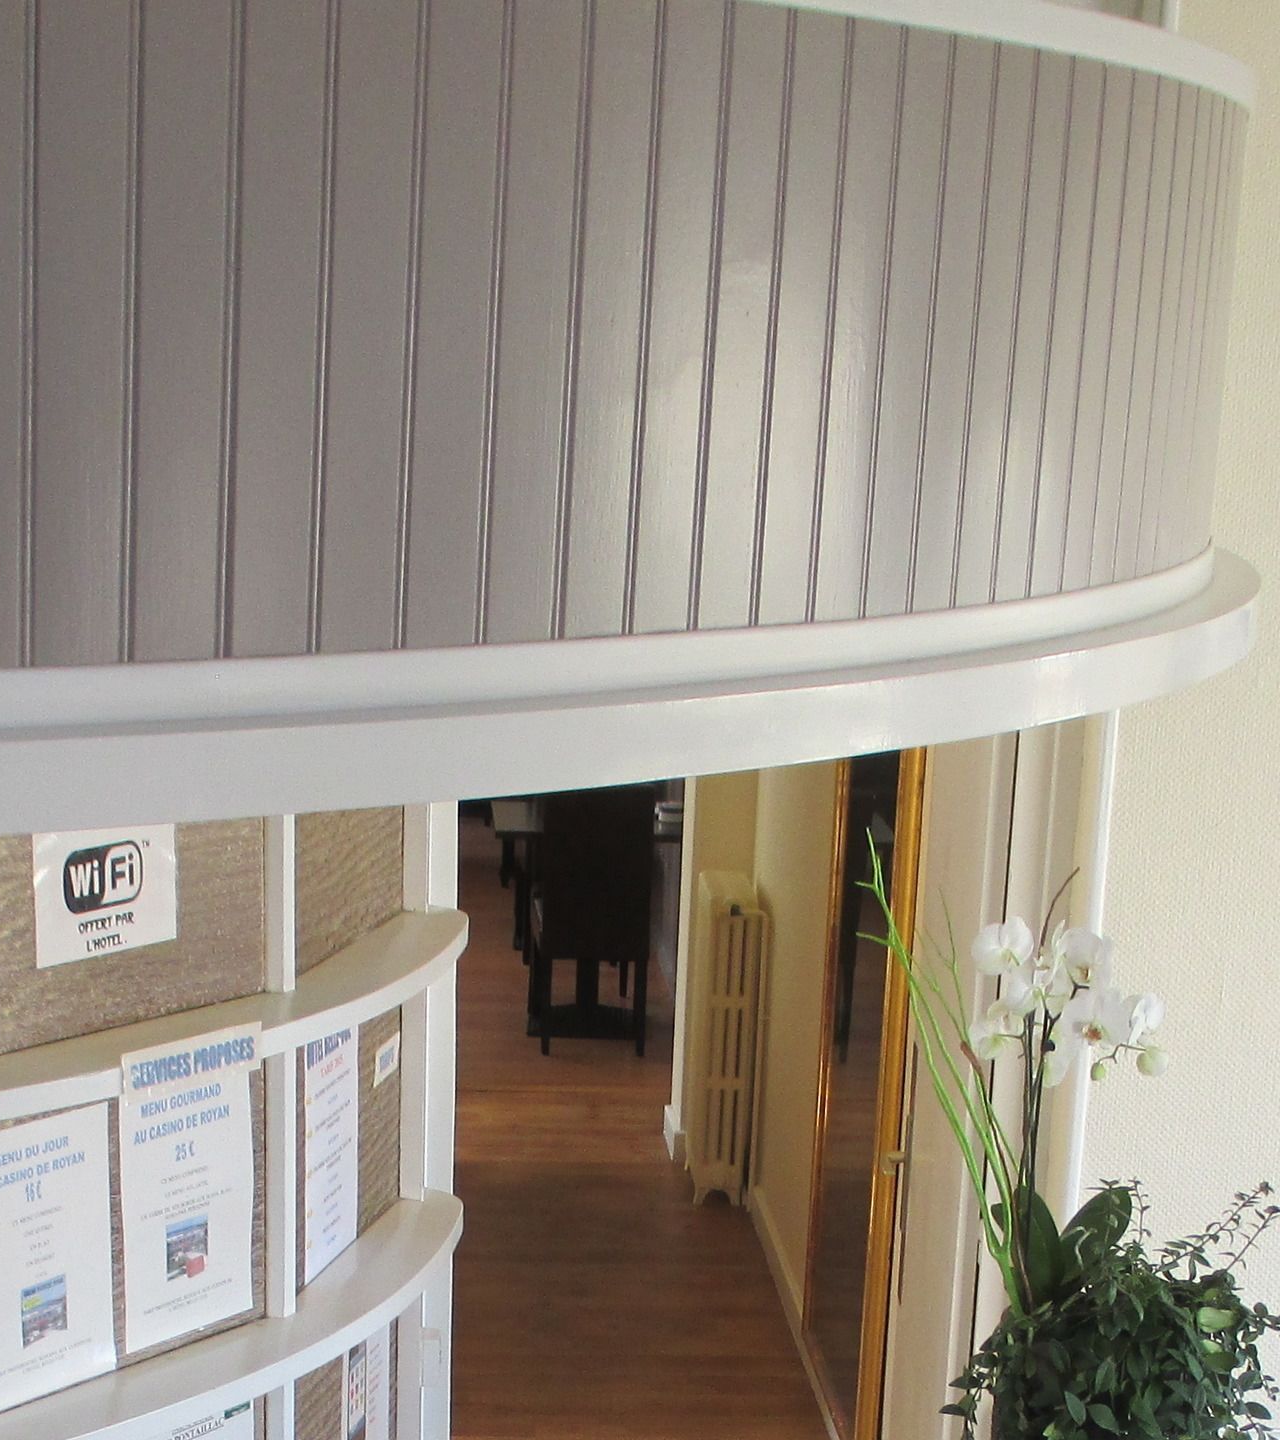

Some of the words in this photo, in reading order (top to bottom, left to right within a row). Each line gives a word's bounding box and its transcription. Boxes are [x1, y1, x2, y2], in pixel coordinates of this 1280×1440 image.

[69, 852, 136, 899] WiFi
[78, 915, 113, 935] OFFERT
[115, 911, 135, 926] PAR
[130, 1051, 191, 1091] SERVICES
[193, 1036, 256, 1076] PROPOSES
[140, 1094, 168, 1119] MENU
[170, 1082, 222, 1110] GOURMAND
[134, 1126, 147, 1146] AU
[149, 1117, 185, 1142] CASINO
[186, 1114, 199, 1130] DE
[200, 1104, 231, 1127] ROYAN
[25, 1143, 40, 1160] DU
[42, 1136, 69, 1156] JOUR
[175, 1143, 187, 1163] 25
[36, 1161, 51, 1177] DE
[52, 1152, 86, 1171] ROYAN
